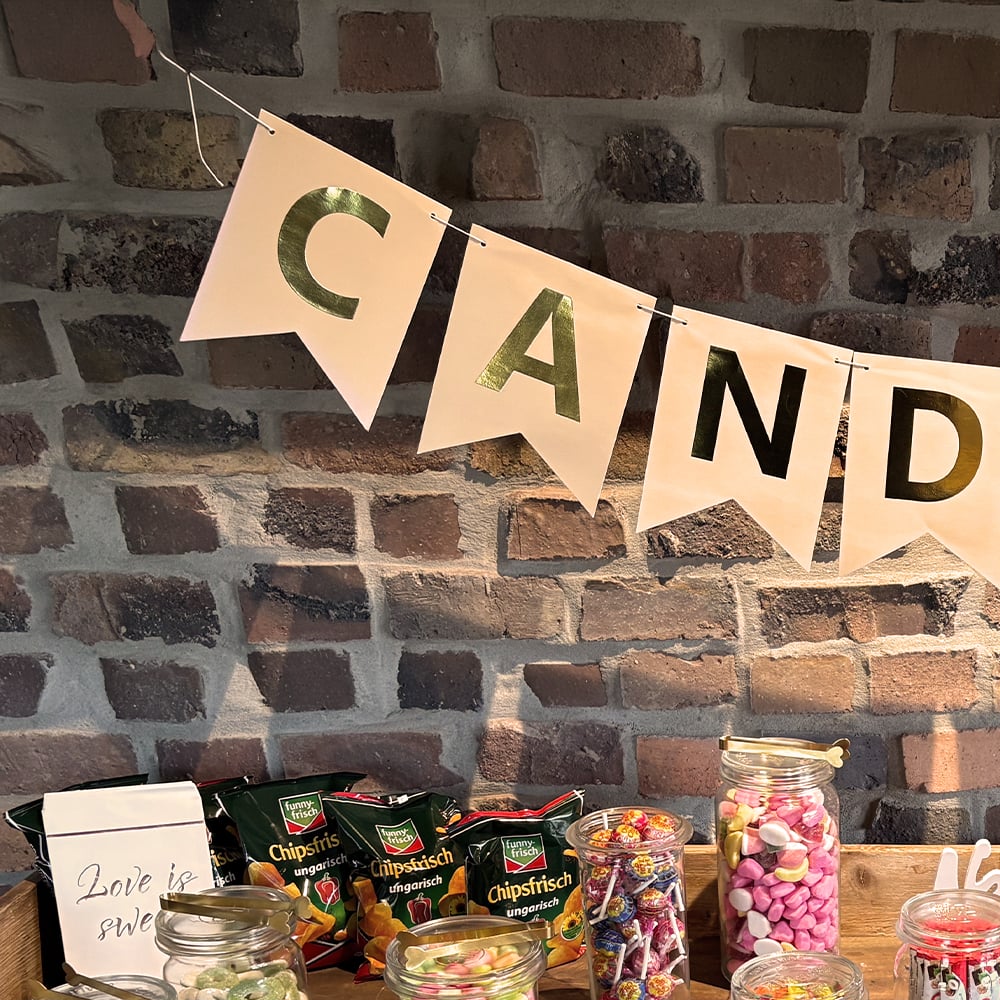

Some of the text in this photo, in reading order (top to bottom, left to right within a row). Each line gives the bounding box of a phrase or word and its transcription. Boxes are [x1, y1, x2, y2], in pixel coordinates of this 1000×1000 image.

[284, 800, 315, 811] funny-
[291, 807, 318, 820] frisch
[380, 828, 409, 838] funny-
[387, 834, 414, 845] frisch
[268, 831, 341, 863] Chipsfris
[506, 839, 536, 850] funny-
[511, 846, 539, 858] frisch
[294, 853, 348, 877] ungarisch
[370, 847, 454, 879] Chipsfrisch
[75, 863, 153, 905] Love
[167, 862, 199, 892] is
[389, 874, 443, 894] ungarisch
[487, 871, 573, 904] Chipsfrisch
[506, 896, 559, 918] ungarisch
[97, 906, 153, 941] swe
